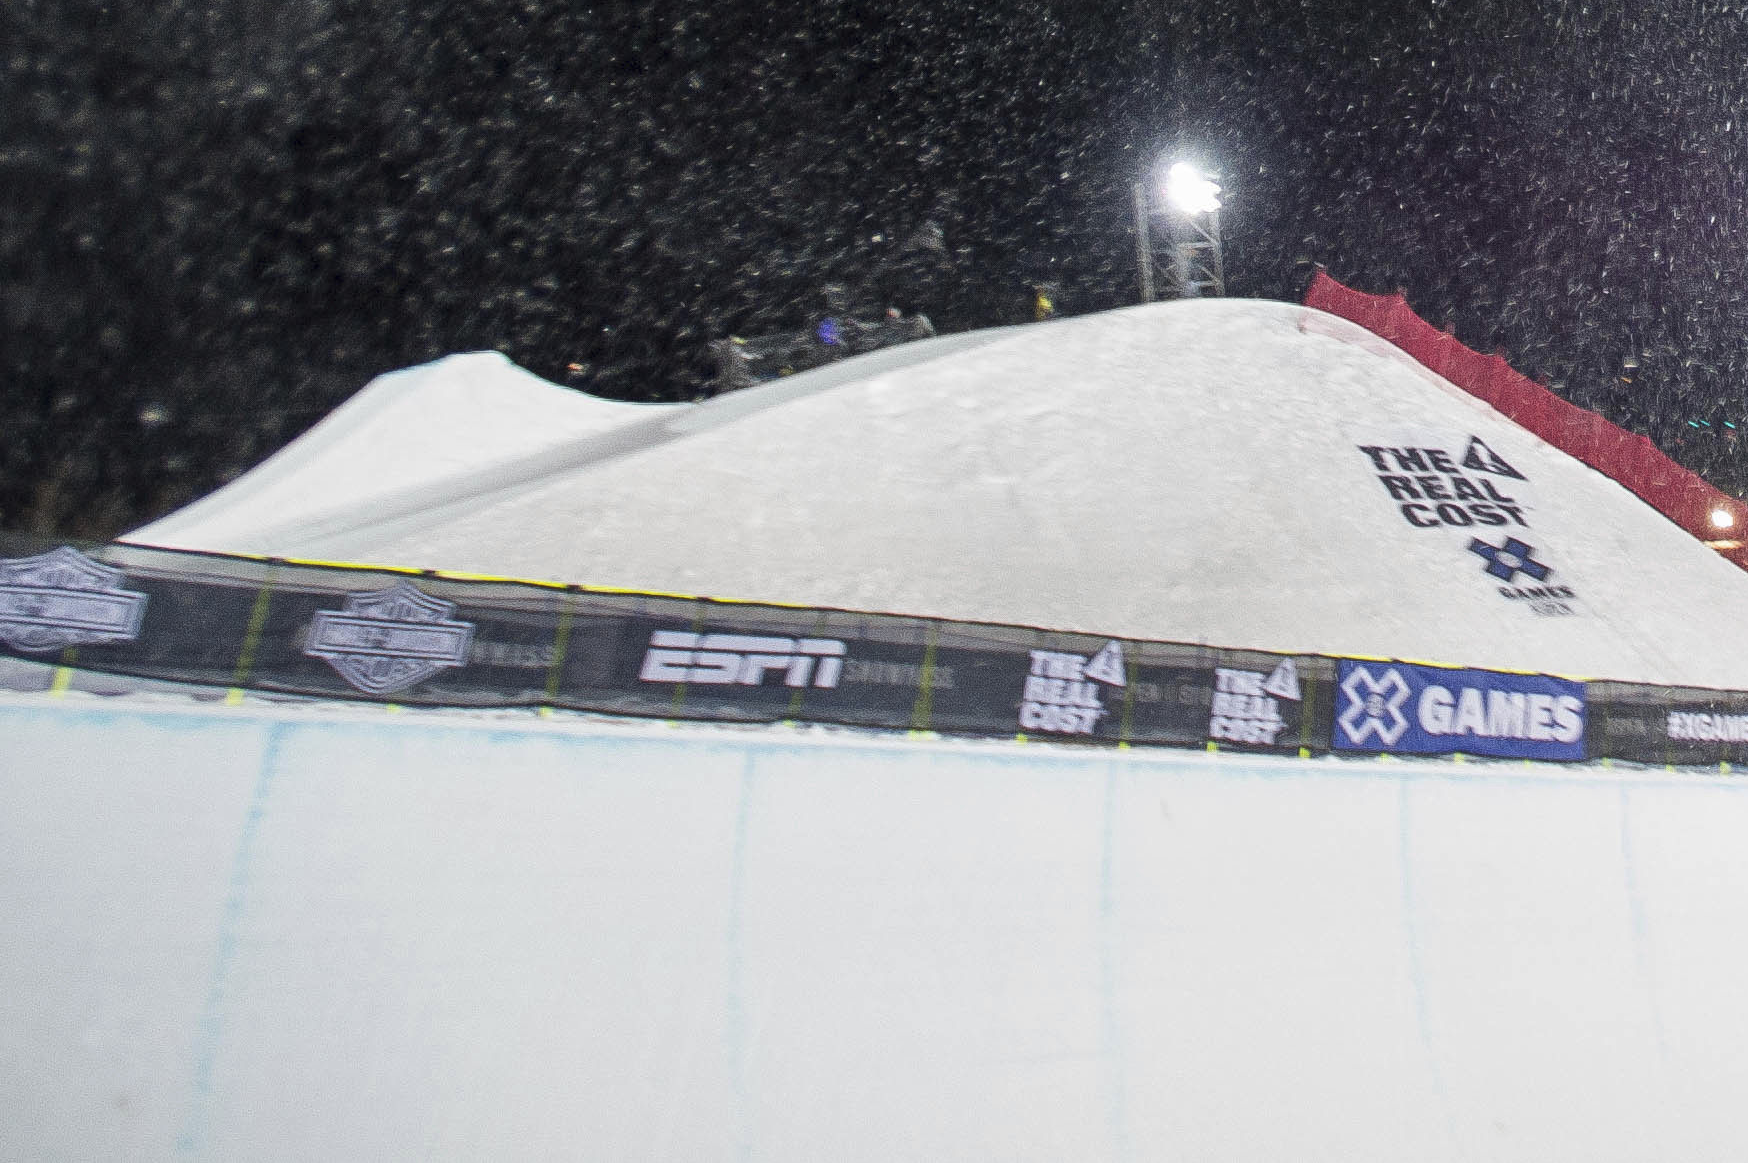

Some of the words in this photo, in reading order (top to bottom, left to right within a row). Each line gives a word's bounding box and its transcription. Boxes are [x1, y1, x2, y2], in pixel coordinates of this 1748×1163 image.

[1357, 445, 1462, 475] THE
[1377, 475, 1515, 503] REAL
[1401, 503, 1529, 528] COST
[639, 630, 847, 688] ESPN
[1417, 685, 1584, 743] GAMES
